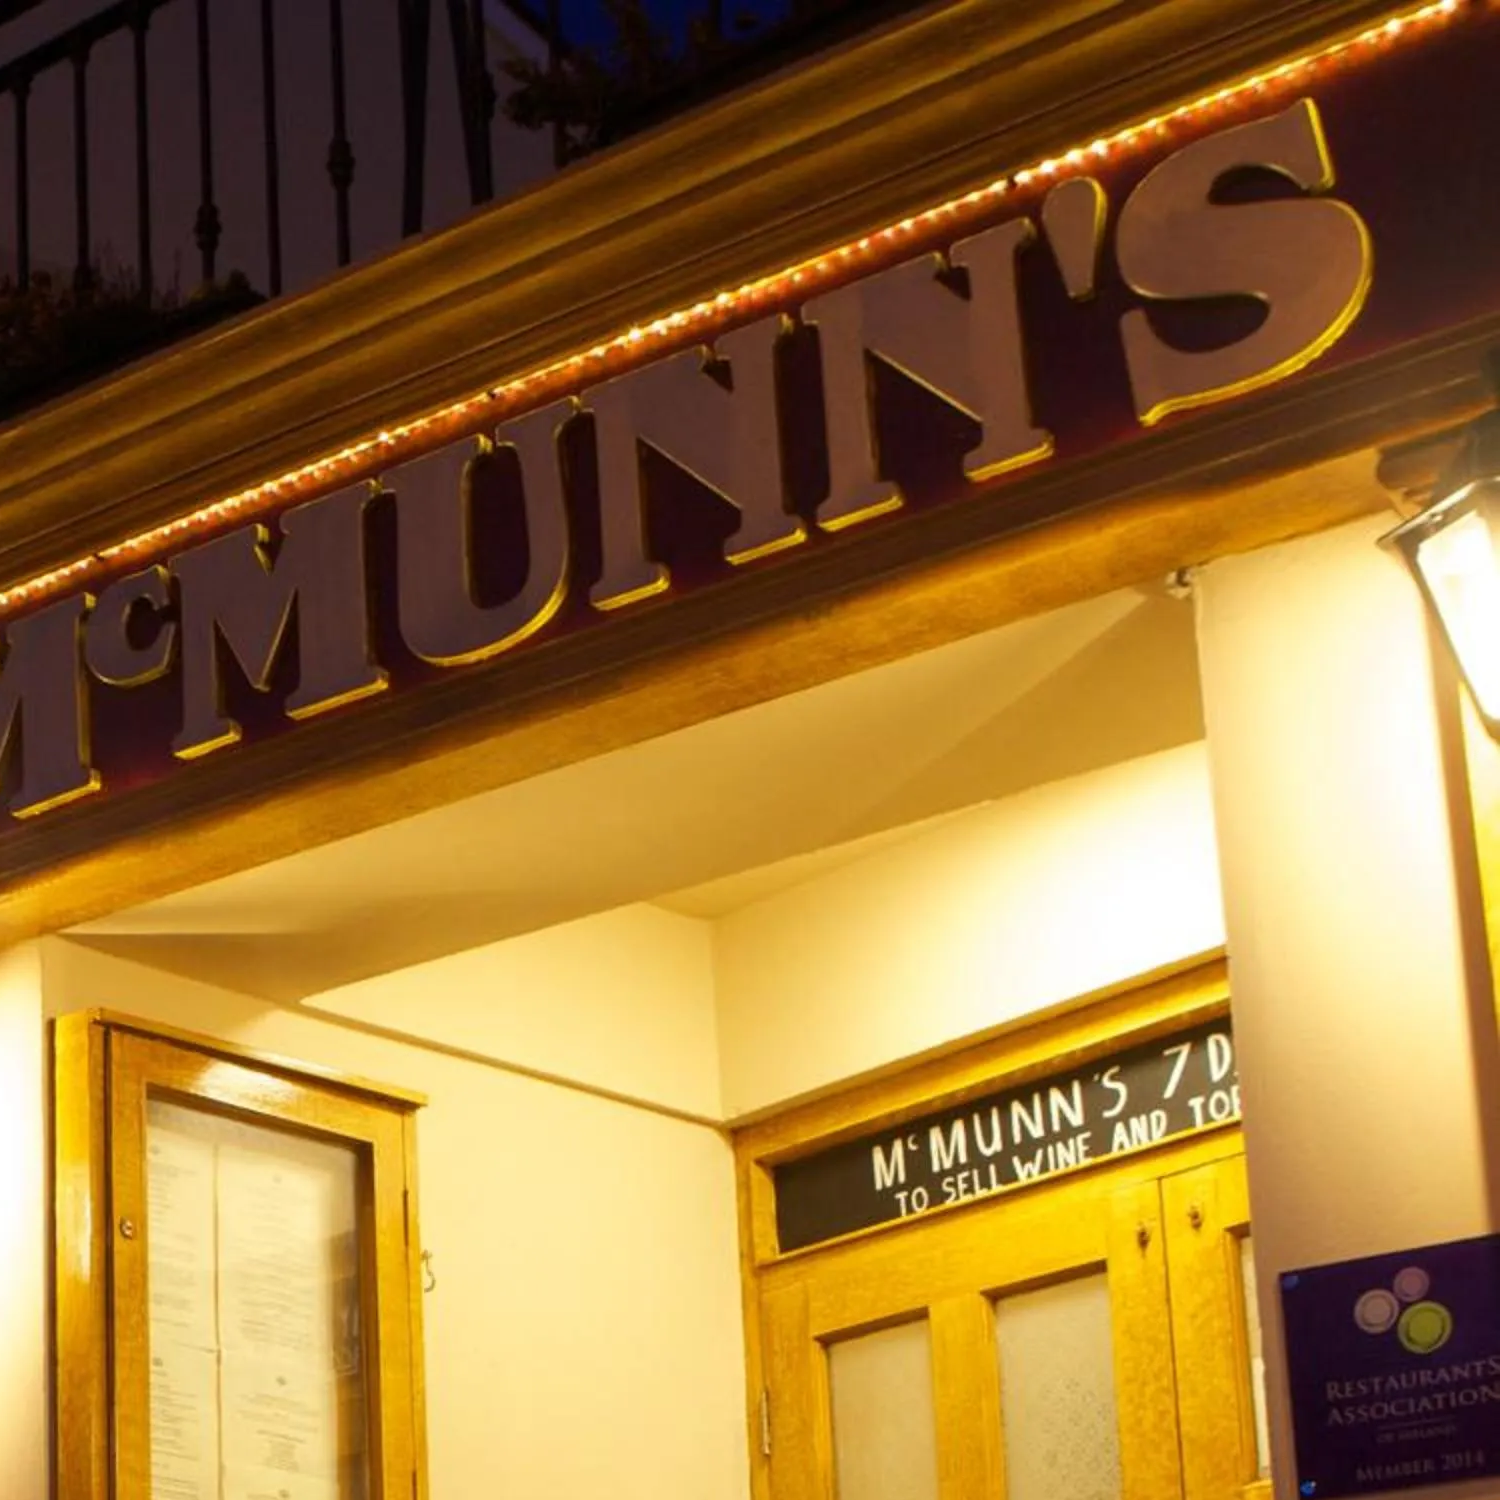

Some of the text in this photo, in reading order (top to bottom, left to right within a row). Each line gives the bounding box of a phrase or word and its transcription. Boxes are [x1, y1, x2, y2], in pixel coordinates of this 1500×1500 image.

[1163, 1042, 1192, 1099] 7
[1207, 1033, 1239, 1082] D
[895, 1186, 928, 1217] TO
[942, 1165, 1005, 1206] SELL
[1013, 1132, 1093, 1184] WINE
[1111, 1110, 1167, 1154] AND
[1325, 1355, 1500, 1403] RESTAURANTS
[1327, 1380, 1500, 1427] ASSOCIATION
